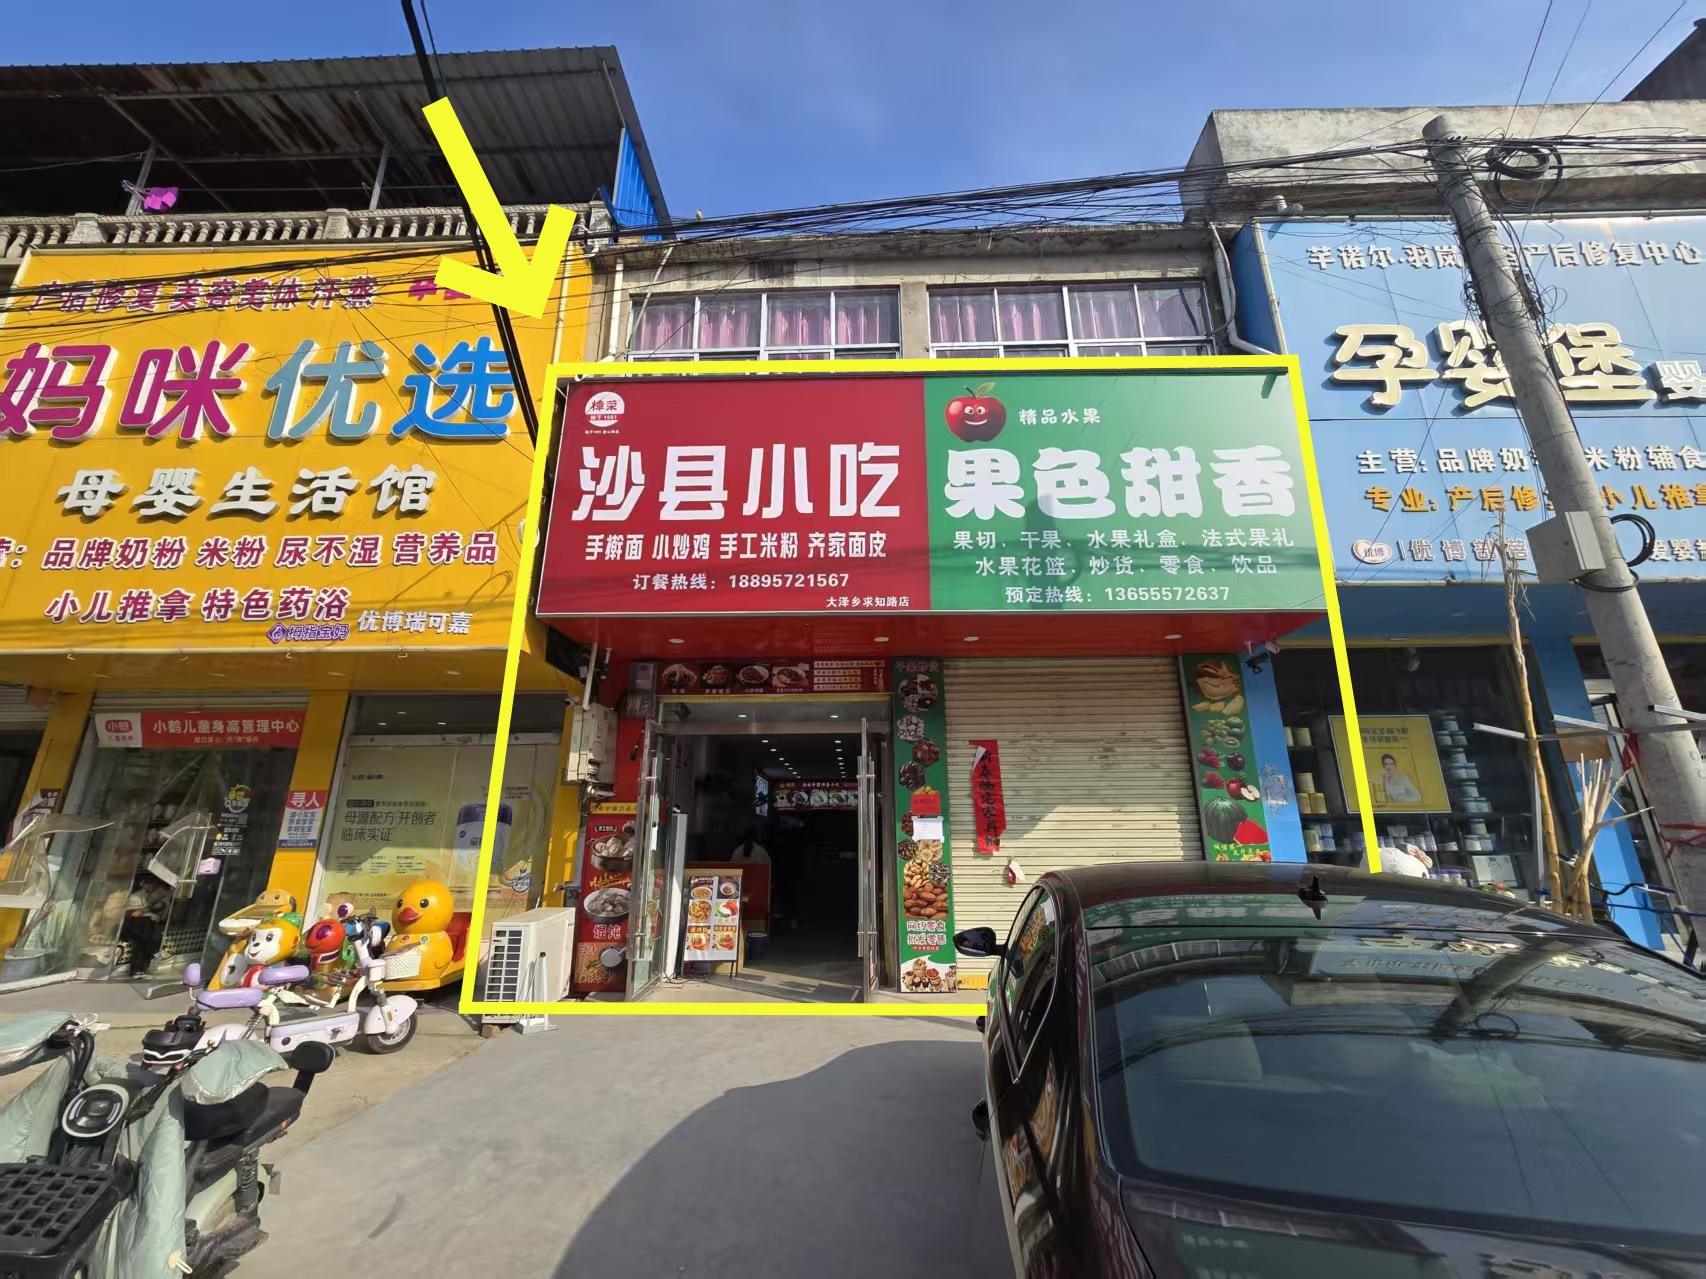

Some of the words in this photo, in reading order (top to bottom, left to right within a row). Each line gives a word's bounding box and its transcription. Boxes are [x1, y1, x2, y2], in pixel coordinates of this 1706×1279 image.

[168, 277, 304, 313] 美容美体
[307, 274, 378, 310] 汗蒸
[0, 335, 517, 443] 妈咪优选
[1018, 408, 1101, 426] 精品水果
[56, 464, 438, 519] 母婴生活馆
[571, 442, 901, 522] 沙县小吃
[944, 445, 1296, 520] 果色甜香
[41, 536, 188, 571] 品牌奶粉
[195, 536, 268, 569] 米粉
[275, 535, 381, 568] 尿不湿
[391, 531, 498, 566] 营养品
[651, 531, 711, 561] 小炒鸡
[719, 530, 799, 560] 手工米粉
[807, 530, 888, 558] 齐家面皮
[44, 589, 193, 623] 小儿推拿
[201, 587, 350, 622] 特色药浴
[826, 595, 911, 609] 大泽乡求知路店
[357, 610, 474, 635] 优博瑞可嘉
[153, 718, 300, 734] 小鹤儿童身高管理中心
[290, 791, 320, 808] 寻人
